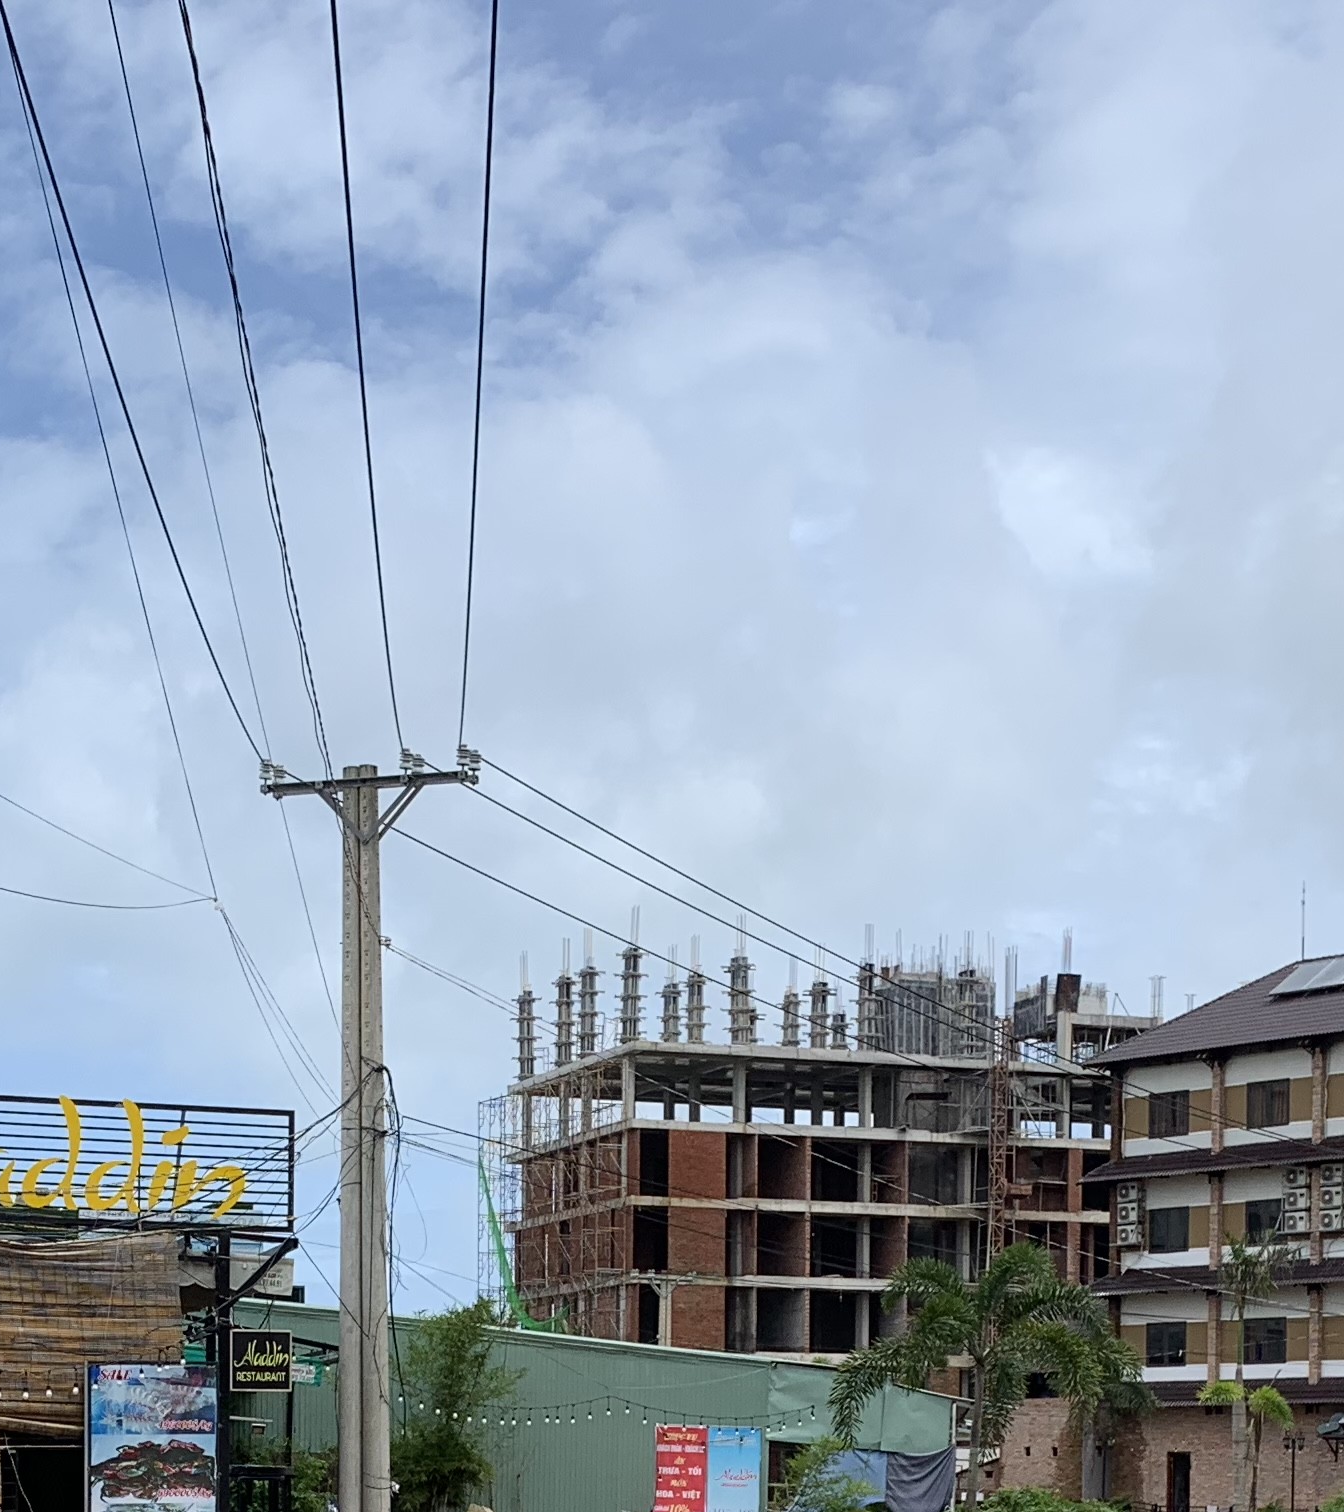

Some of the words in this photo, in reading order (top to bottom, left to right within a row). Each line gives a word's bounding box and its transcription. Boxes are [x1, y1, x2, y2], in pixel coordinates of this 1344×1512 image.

[233, 1339, 290, 1368] Aladdin
[235, 1371, 287, 1382] RESTAURANT
[656, 1490, 674, 1498] HOA
[681, 1489, 701, 1500] VIỆT
